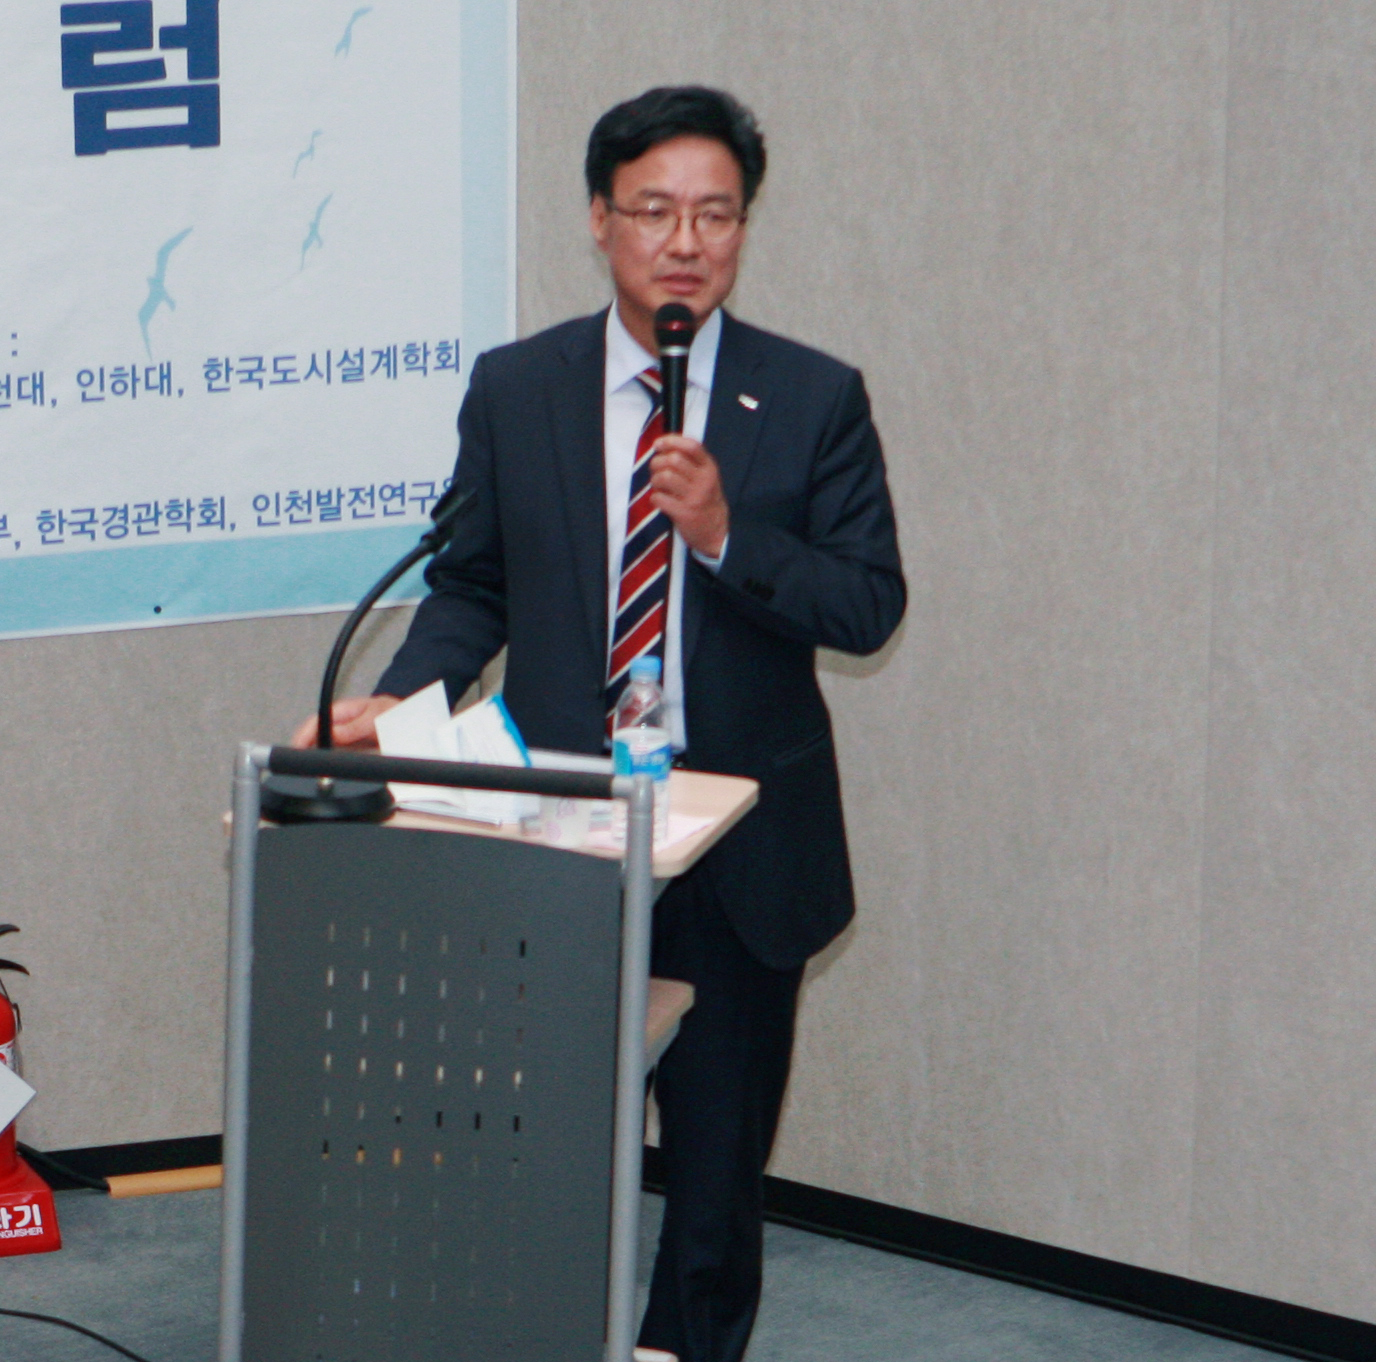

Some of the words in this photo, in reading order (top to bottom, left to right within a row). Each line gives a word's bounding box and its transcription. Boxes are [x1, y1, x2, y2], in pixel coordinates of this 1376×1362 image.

[60, 0, 221, 156] 럼
[75, 360, 185, 403] 인하대,
[202, 338, 462, 393] 한국도시설계학회
[35, 495, 237, 545] 한국경관학회,
[252, 477, 453, 528] 인천발전연구
